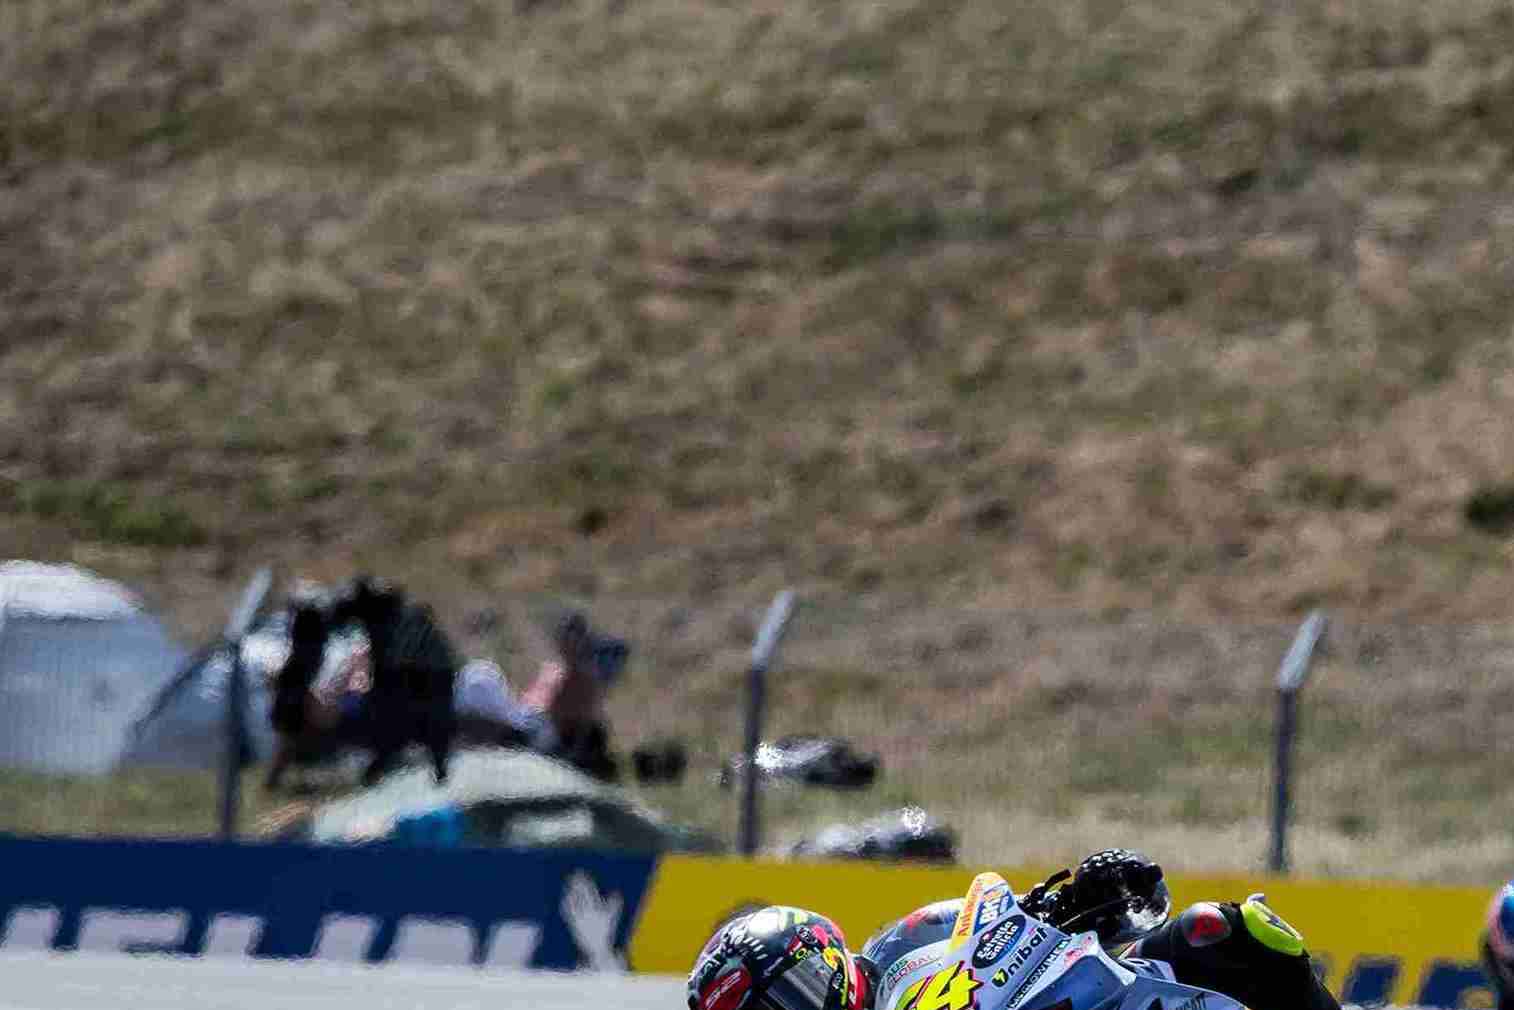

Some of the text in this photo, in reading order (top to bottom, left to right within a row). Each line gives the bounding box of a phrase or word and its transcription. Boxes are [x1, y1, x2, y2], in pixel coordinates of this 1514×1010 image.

[977, 921, 1014, 960] Estrella
[984, 924, 1019, 961] Galicia
[991, 926, 1048, 988] Unibat
